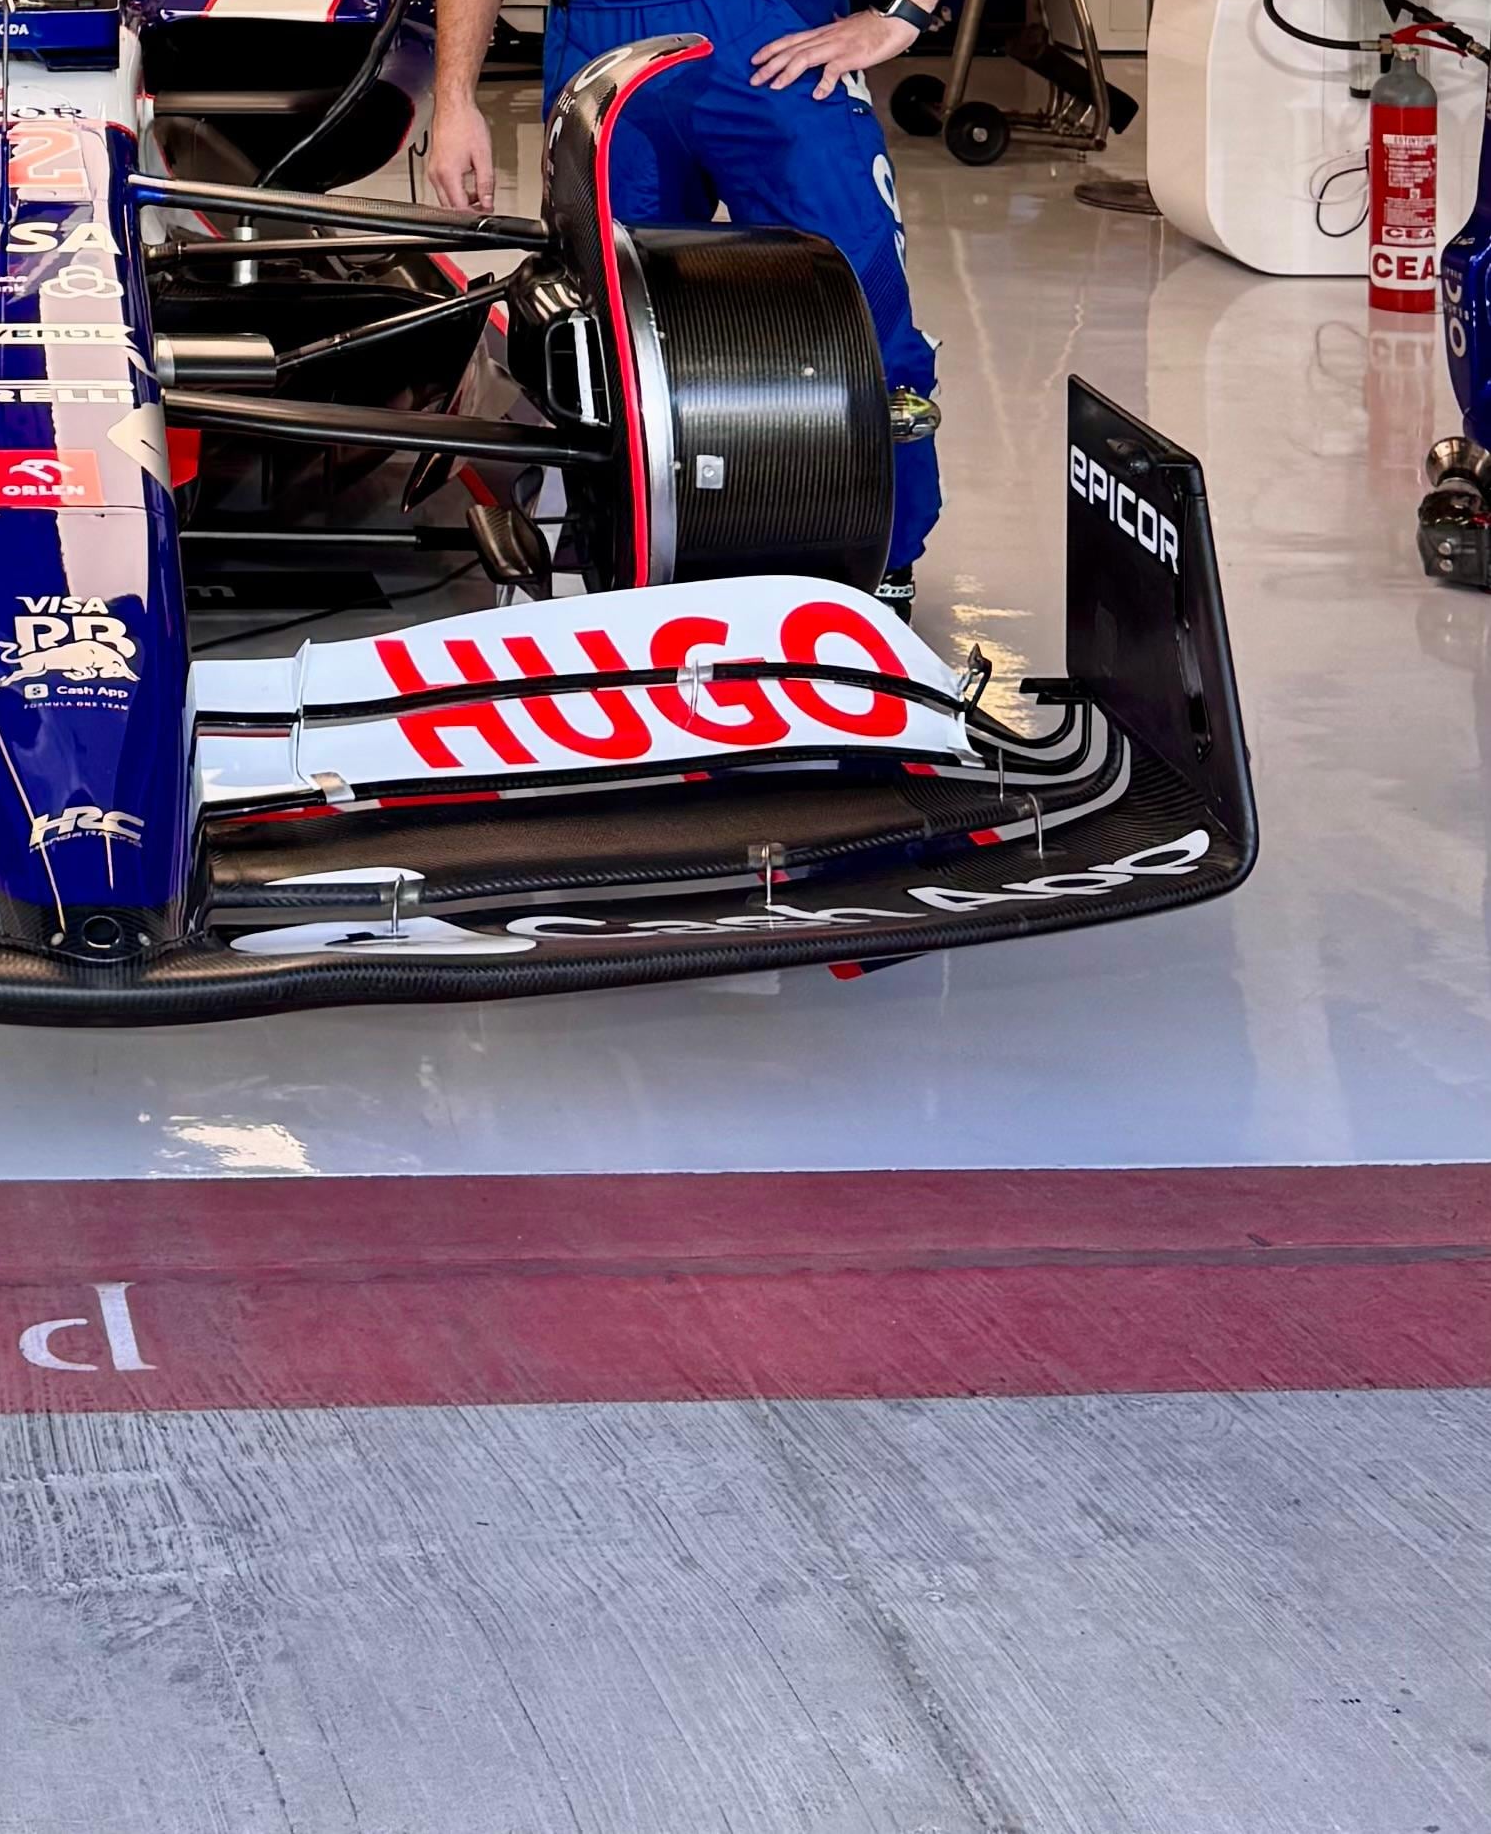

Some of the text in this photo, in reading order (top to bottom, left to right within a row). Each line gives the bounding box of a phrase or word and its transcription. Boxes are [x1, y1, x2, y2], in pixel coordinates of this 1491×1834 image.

[1372, 252, 1434, 281] CEA
[2, 485, 85, 496] ORLEN
[15, 596, 109, 614] VISA
[56, 685, 129, 699] Cash App
[375, 600, 910, 769] HUGO
[505, 827, 1211, 939] Cash App
